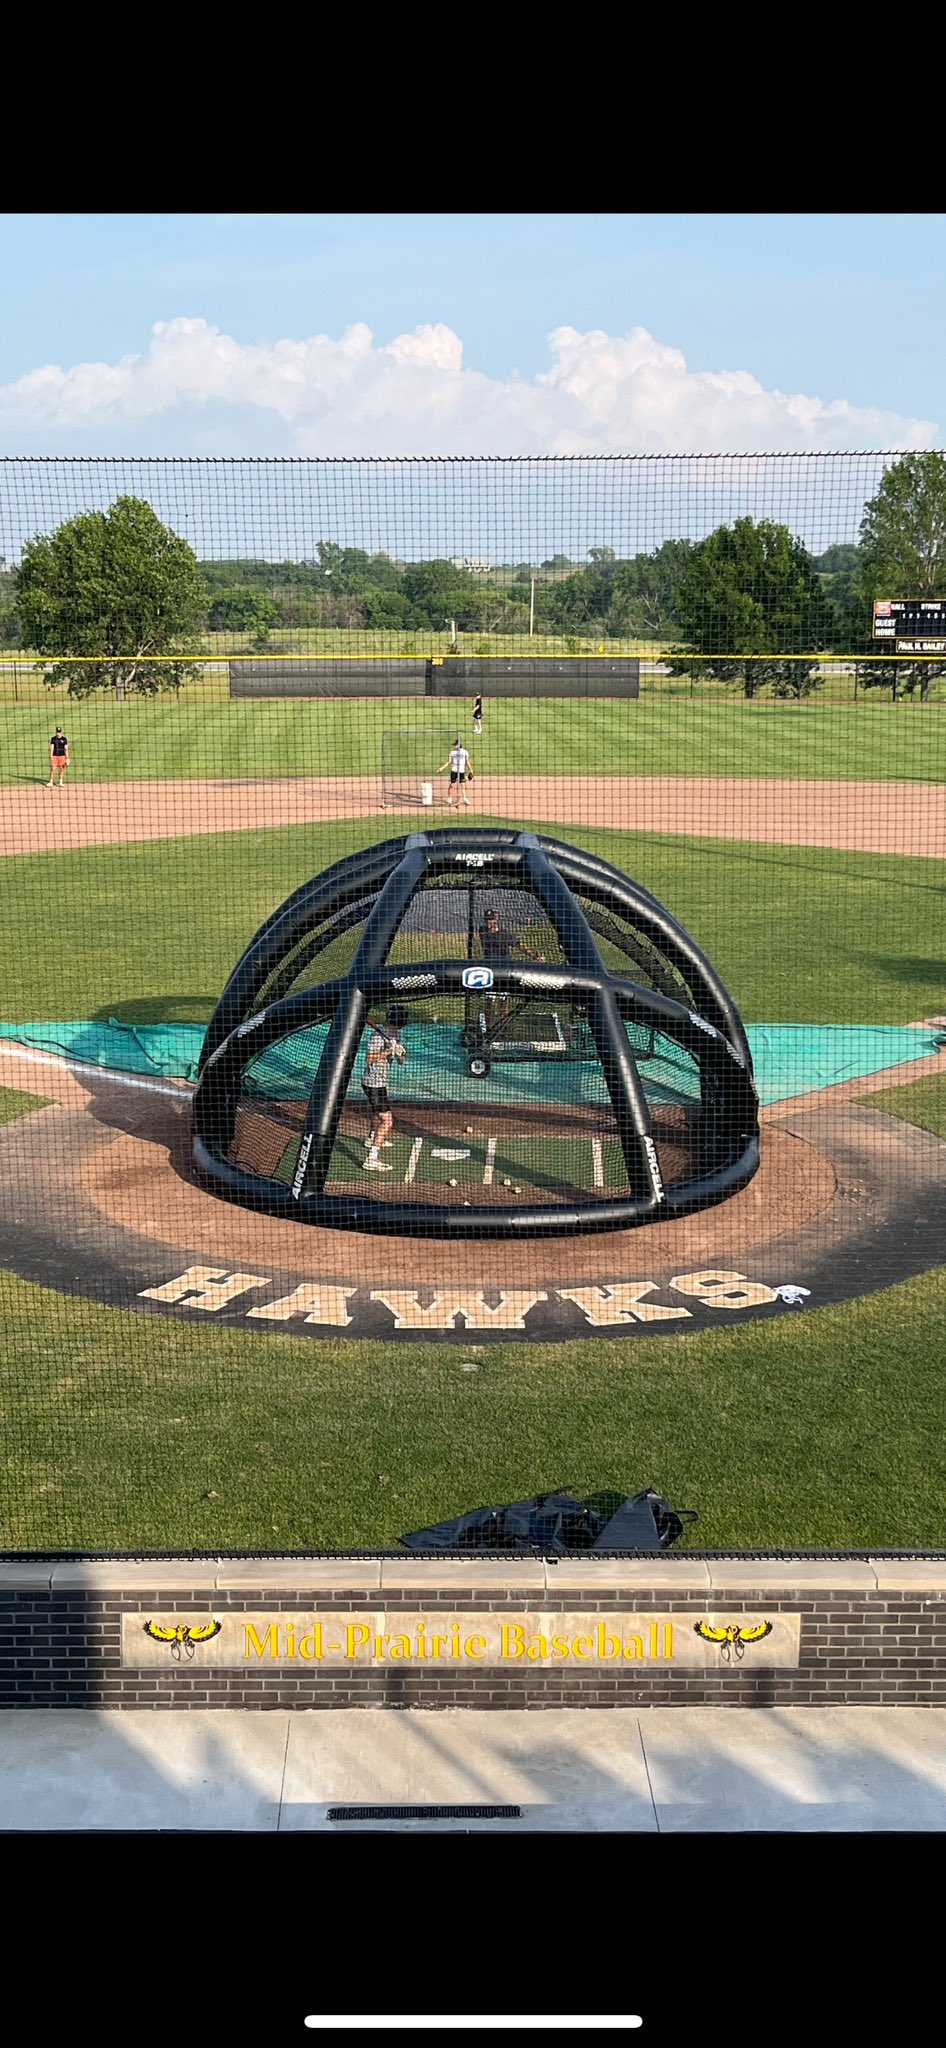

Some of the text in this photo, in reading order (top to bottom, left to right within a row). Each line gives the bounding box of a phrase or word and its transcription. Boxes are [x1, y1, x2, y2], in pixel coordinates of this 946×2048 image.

[875, 619, 896, 627] GUEST
[875, 628, 896, 636] HOME
[898, 641, 914, 650] PAUL
[922, 642, 945, 650] BAILEY
[455, 853, 495, 861] AIRCELL
[292, 1133, 313, 1200] AIRCELL
[643, 1135, 665, 1203] AIRCELL
[137, 1265, 780, 1330] HAWKS
[243, 1622, 675, 1660] Mid-Prairie Baseball
